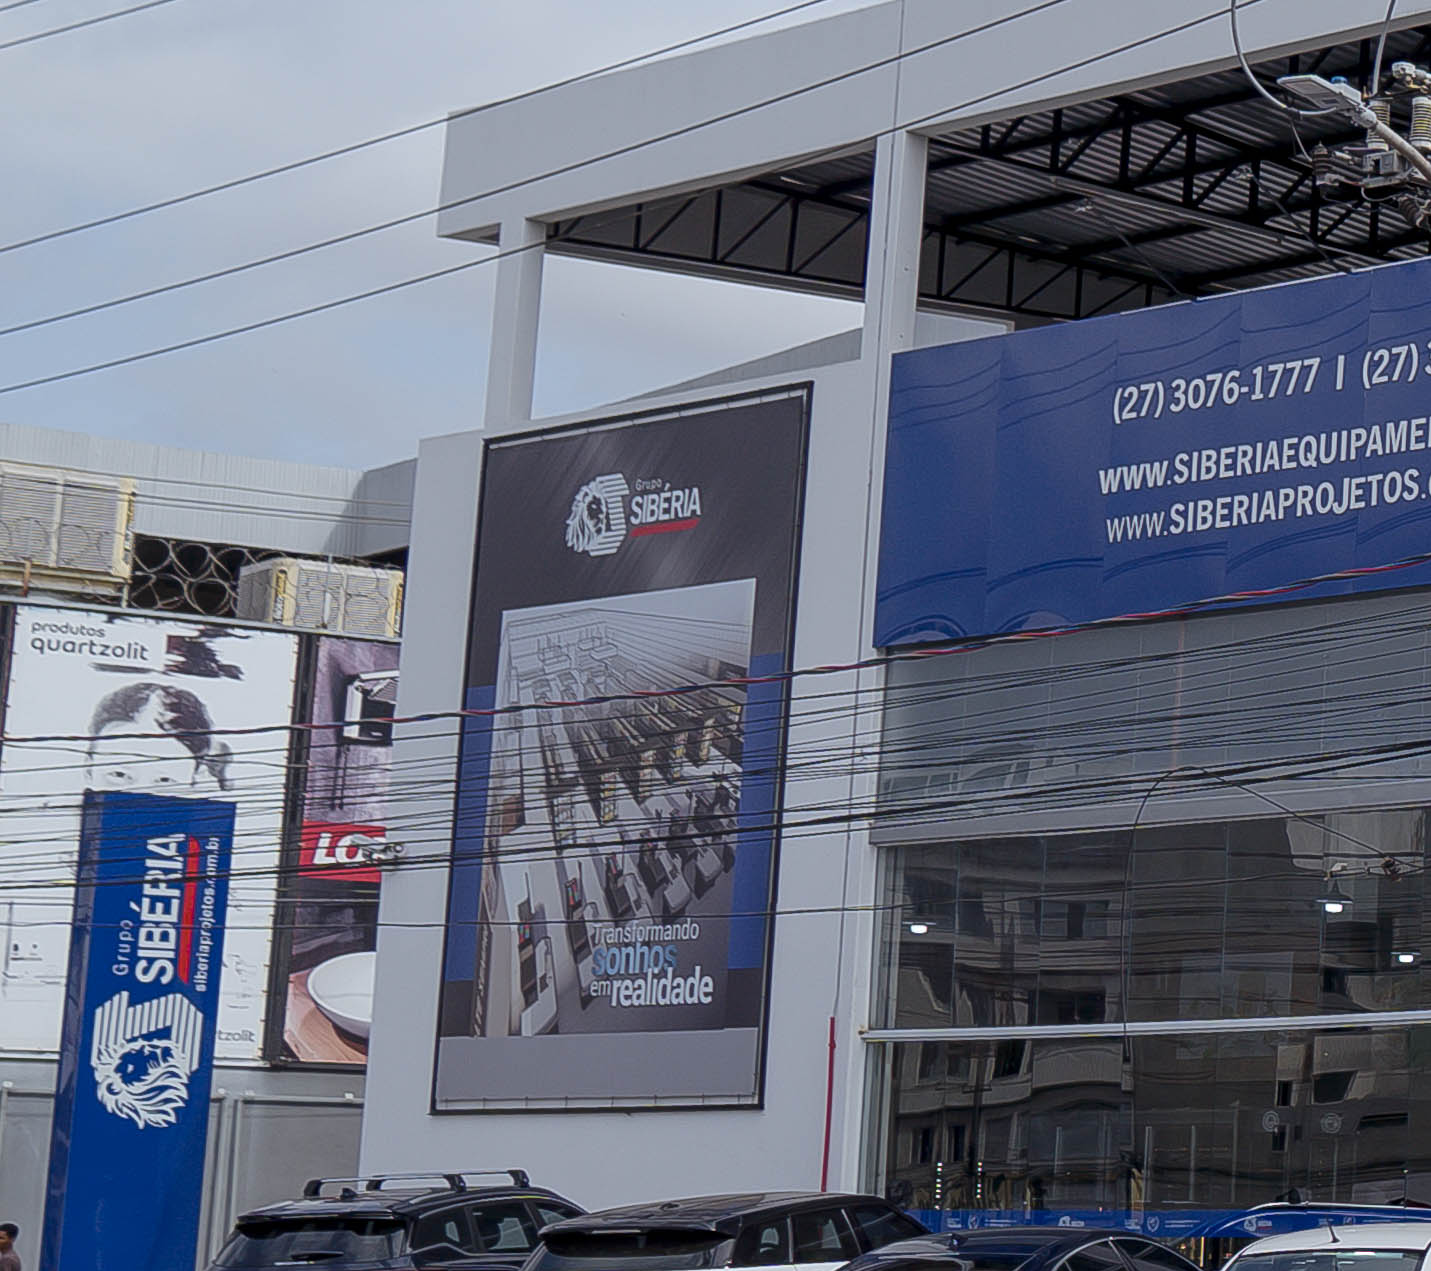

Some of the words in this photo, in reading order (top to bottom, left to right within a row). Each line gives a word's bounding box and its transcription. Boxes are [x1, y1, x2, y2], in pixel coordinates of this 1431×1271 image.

[1113, 384, 1165, 425] (27)
[1169, 358, 1320, 412] 3076-1777
[1362, 342, 1419, 390] (27)
[630, 483, 701, 525] SIBÉRIA
[30, 636, 150, 662] quartzolit
[31, 621, 105, 638] produtos
[130, 833, 187, 985] SIBÉRIA
[113, 919, 133, 976] Grupo
[591, 918, 700, 945] Transformando
[592, 943, 678, 976] sonhos
[590, 980, 611, 997] em
[610, 966, 714, 1007] realidade
